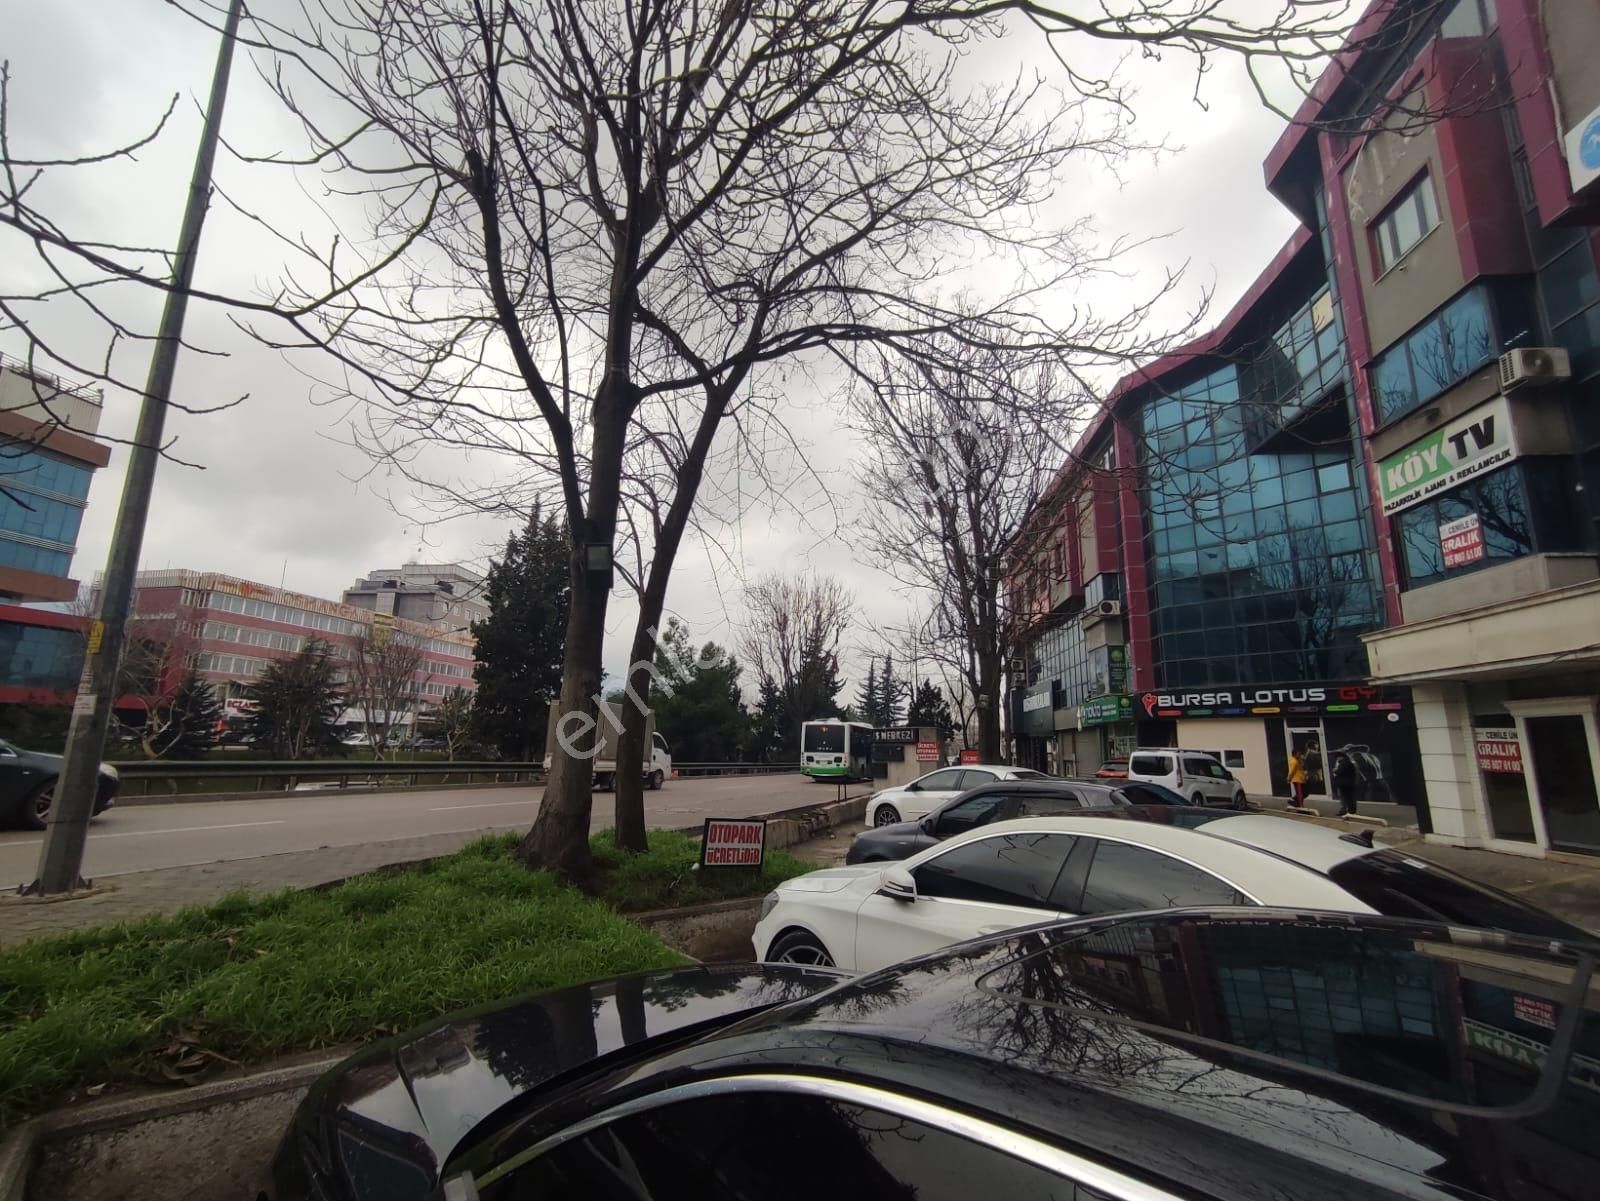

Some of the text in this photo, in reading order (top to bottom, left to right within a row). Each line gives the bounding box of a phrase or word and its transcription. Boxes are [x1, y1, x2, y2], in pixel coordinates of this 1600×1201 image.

[1387, 414, 1494, 492] KÖY TV
[1456, 447, 1511, 480] REKLAMCILIK
[1157, 692, 1232, 707] BURSA
[1241, 688, 1326, 704] LOTUS
[709, 824, 762, 844] OTOPARK
[706, 847, 760, 863] ÜCRETLİDİR
